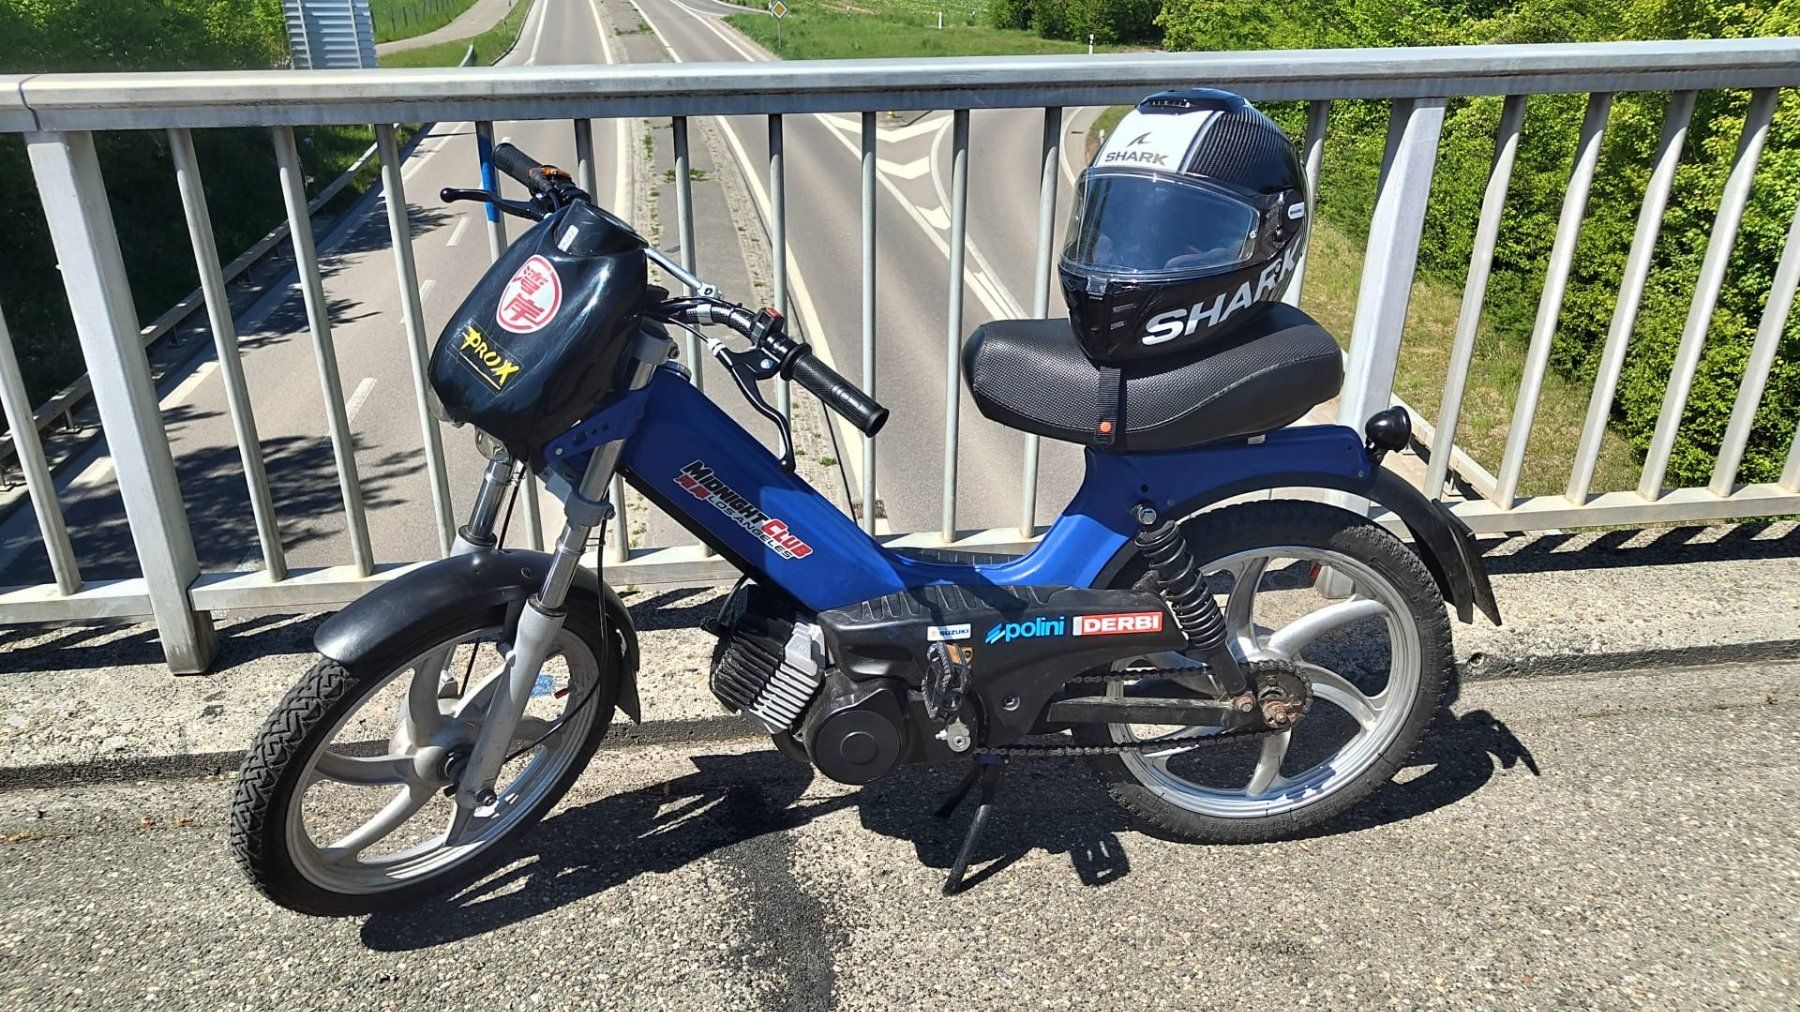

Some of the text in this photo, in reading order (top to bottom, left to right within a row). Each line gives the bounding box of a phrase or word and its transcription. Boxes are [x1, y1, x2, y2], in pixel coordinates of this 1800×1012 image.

[1104, 151, 1169, 166] SHARK
[1142, 237, 1300, 346] SHARK
[681, 461, 812, 558] MIDNIGHT CLUB
[707, 495, 793, 558] LOS ANGELES
[1005, 616, 1064, 642] polini
[1083, 615, 1160, 633] DERBI
